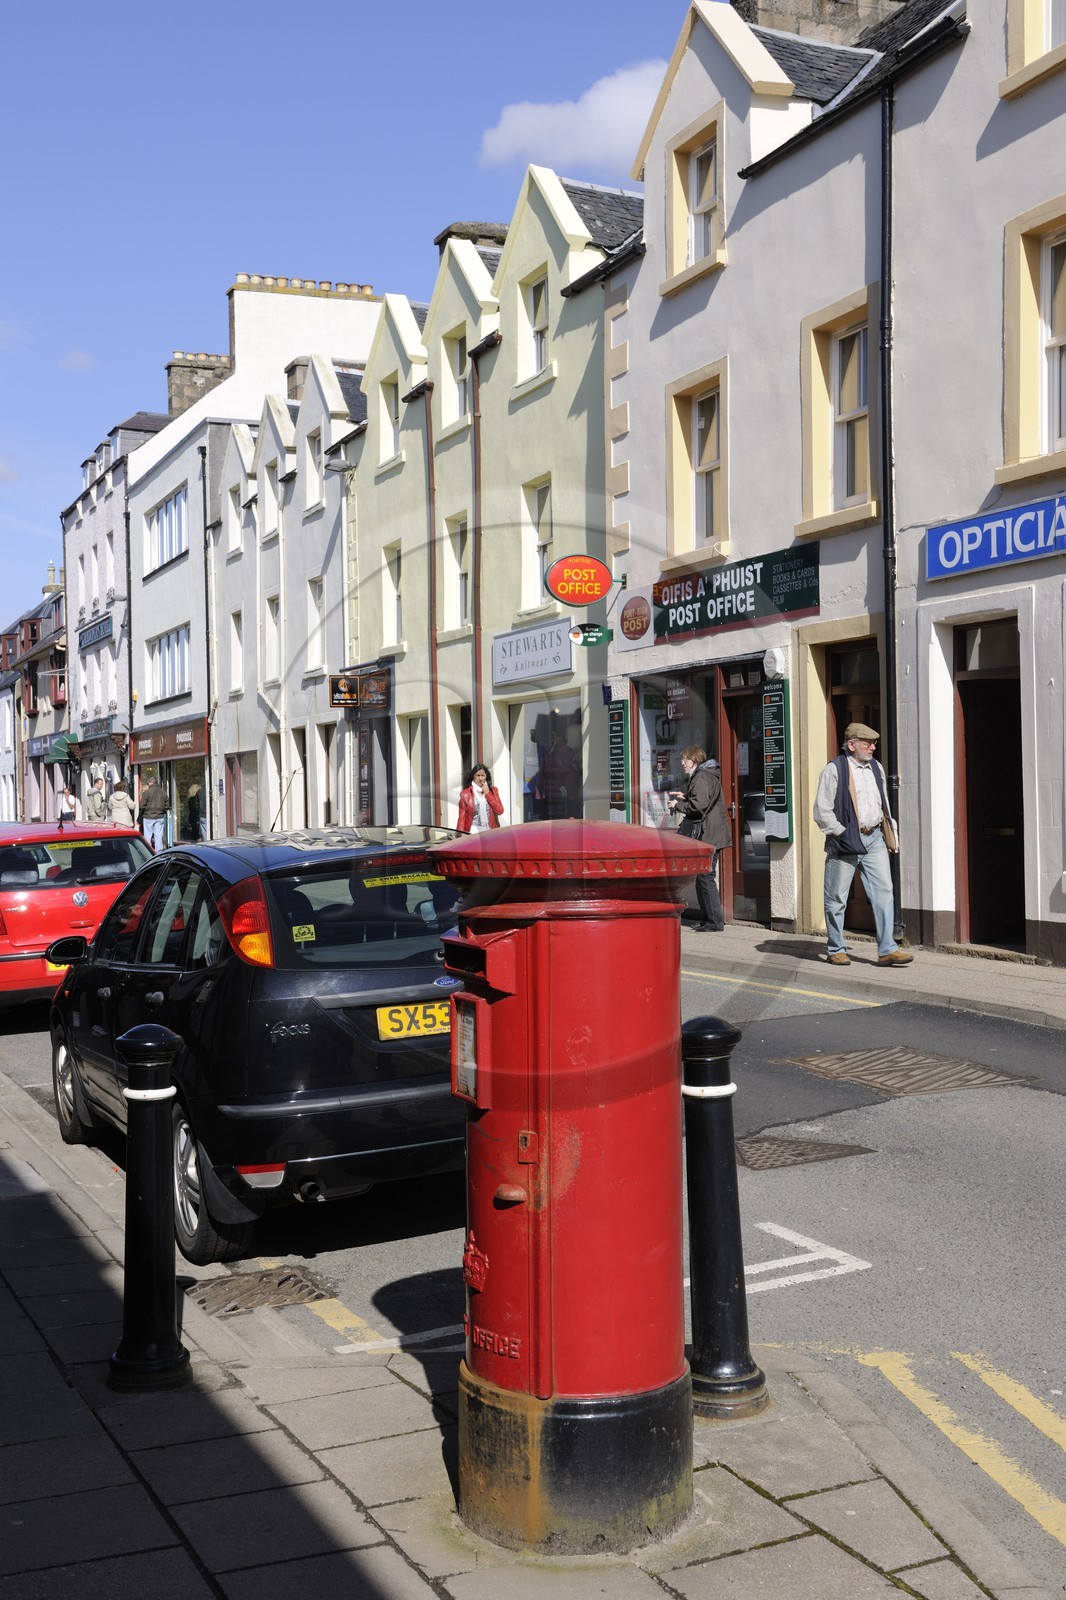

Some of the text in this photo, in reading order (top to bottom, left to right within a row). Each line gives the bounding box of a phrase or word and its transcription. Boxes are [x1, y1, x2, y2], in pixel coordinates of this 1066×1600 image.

[772, 559, 804, 574] STATIONERY
[563, 569, 597, 581] POST
[772, 571, 791, 585] BOOKS
[797, 566, 816, 579] CARDS
[557, 582, 601, 595] OFFICE
[661, 580, 693, 606] OIFIS
[712, 562, 764, 594] PHUIST
[772, 580, 802, 595] CASSETTES
[668, 590, 756, 627] POST OFFICE
[623, 617, 648, 632] POST
[501, 629, 562, 659] STEWARTS
[514, 657, 548, 672] Knitwear
[764, 683, 783, 691] welcome
[388, 1003, 451, 1033] SX53
[473, 1326, 521, 1359] OFFICE
